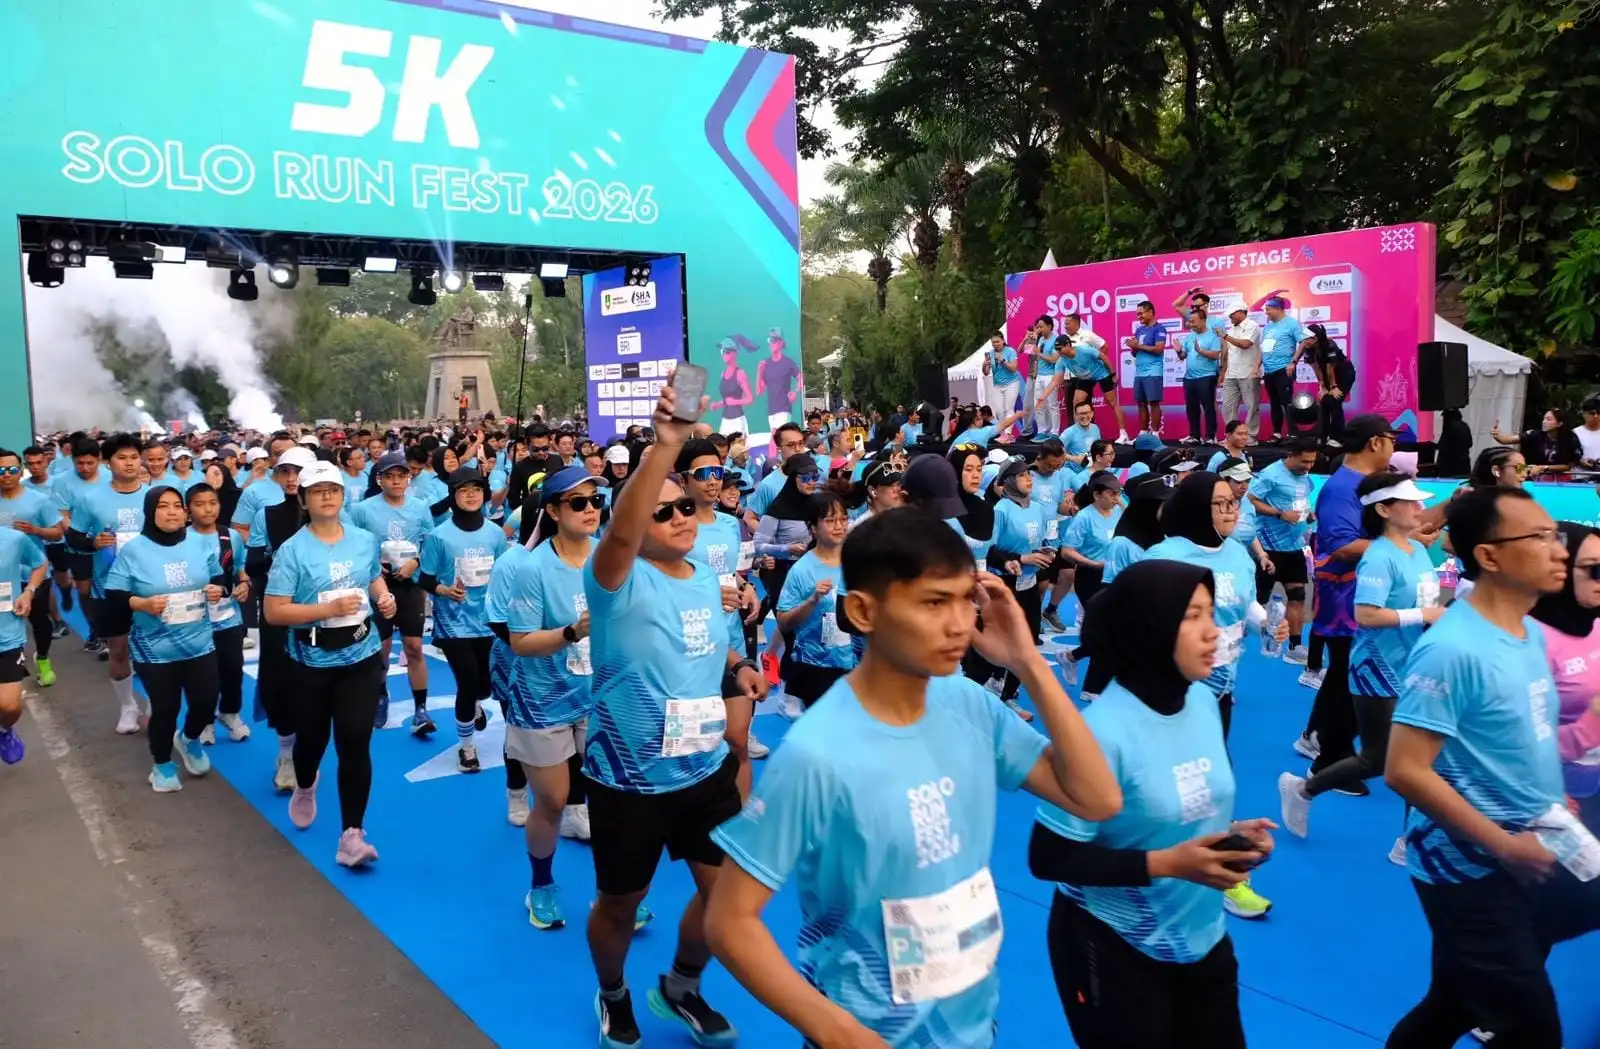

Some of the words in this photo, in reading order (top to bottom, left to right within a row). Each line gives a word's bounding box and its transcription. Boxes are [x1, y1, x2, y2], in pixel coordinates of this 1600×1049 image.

[290, 19, 494, 149] 5K
[61, 130, 255, 196] SOLO
[273, 150, 395, 207] RUN
[411, 163, 530, 216] FEST
[542, 175, 659, 225] 2026
[1163, 259, 1200, 276] FLAG
[1205, 254, 1235, 271] OFF
[1239, 248, 1291, 268] STAGE
[635, 290, 651, 300] SHA
[1323, 279, 1344, 287] SHA
[1046, 289, 1111, 317] SOLO
[679, 608, 712, 623] SOLO
[906, 776, 955, 811] SOLO
